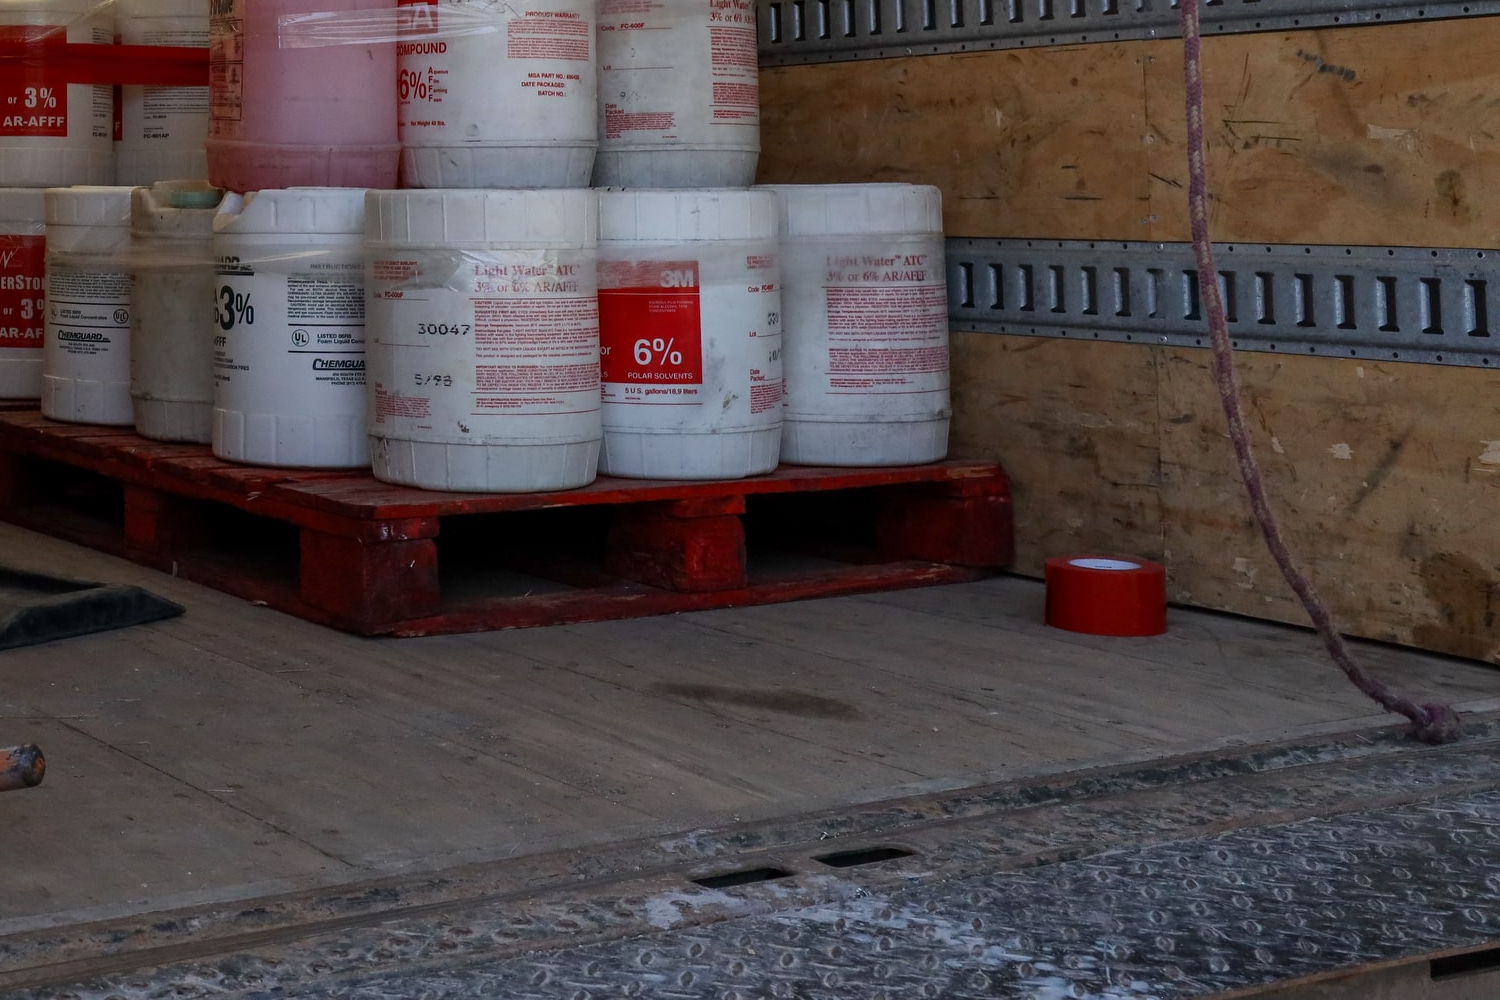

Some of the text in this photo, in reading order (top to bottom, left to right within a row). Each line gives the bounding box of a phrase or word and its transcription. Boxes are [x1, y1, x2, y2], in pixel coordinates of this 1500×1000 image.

[710, 12, 723, 22] 3%
[724, 14, 732, 22] or
[7, 95, 18, 105] or
[24, 87, 57, 109] 3%
[3, 116, 65, 127] AR-AFFF
[827, 256, 858, 269] Light
[475, 264, 508, 277] Light
[827, 270, 927, 281] 3% or 6% AR/AFFF
[660, 270, 694, 288] 3M
[474, 281, 493, 293] 3%
[497, 284, 510, 292] or
[512, 280, 530, 293] 6%
[3, 307, 12, 315] or
[220, 285, 255, 330] 3%
[58, 330, 103, 341] CHEMGUARD
[418, 323, 471, 336] 30047
[294, 332, 307, 344] UL
[600, 337, 683, 366] or 6%
[312, 358, 366, 371] CHEMGUA
[627, 372, 694, 380] POLAR SOLVENTS
